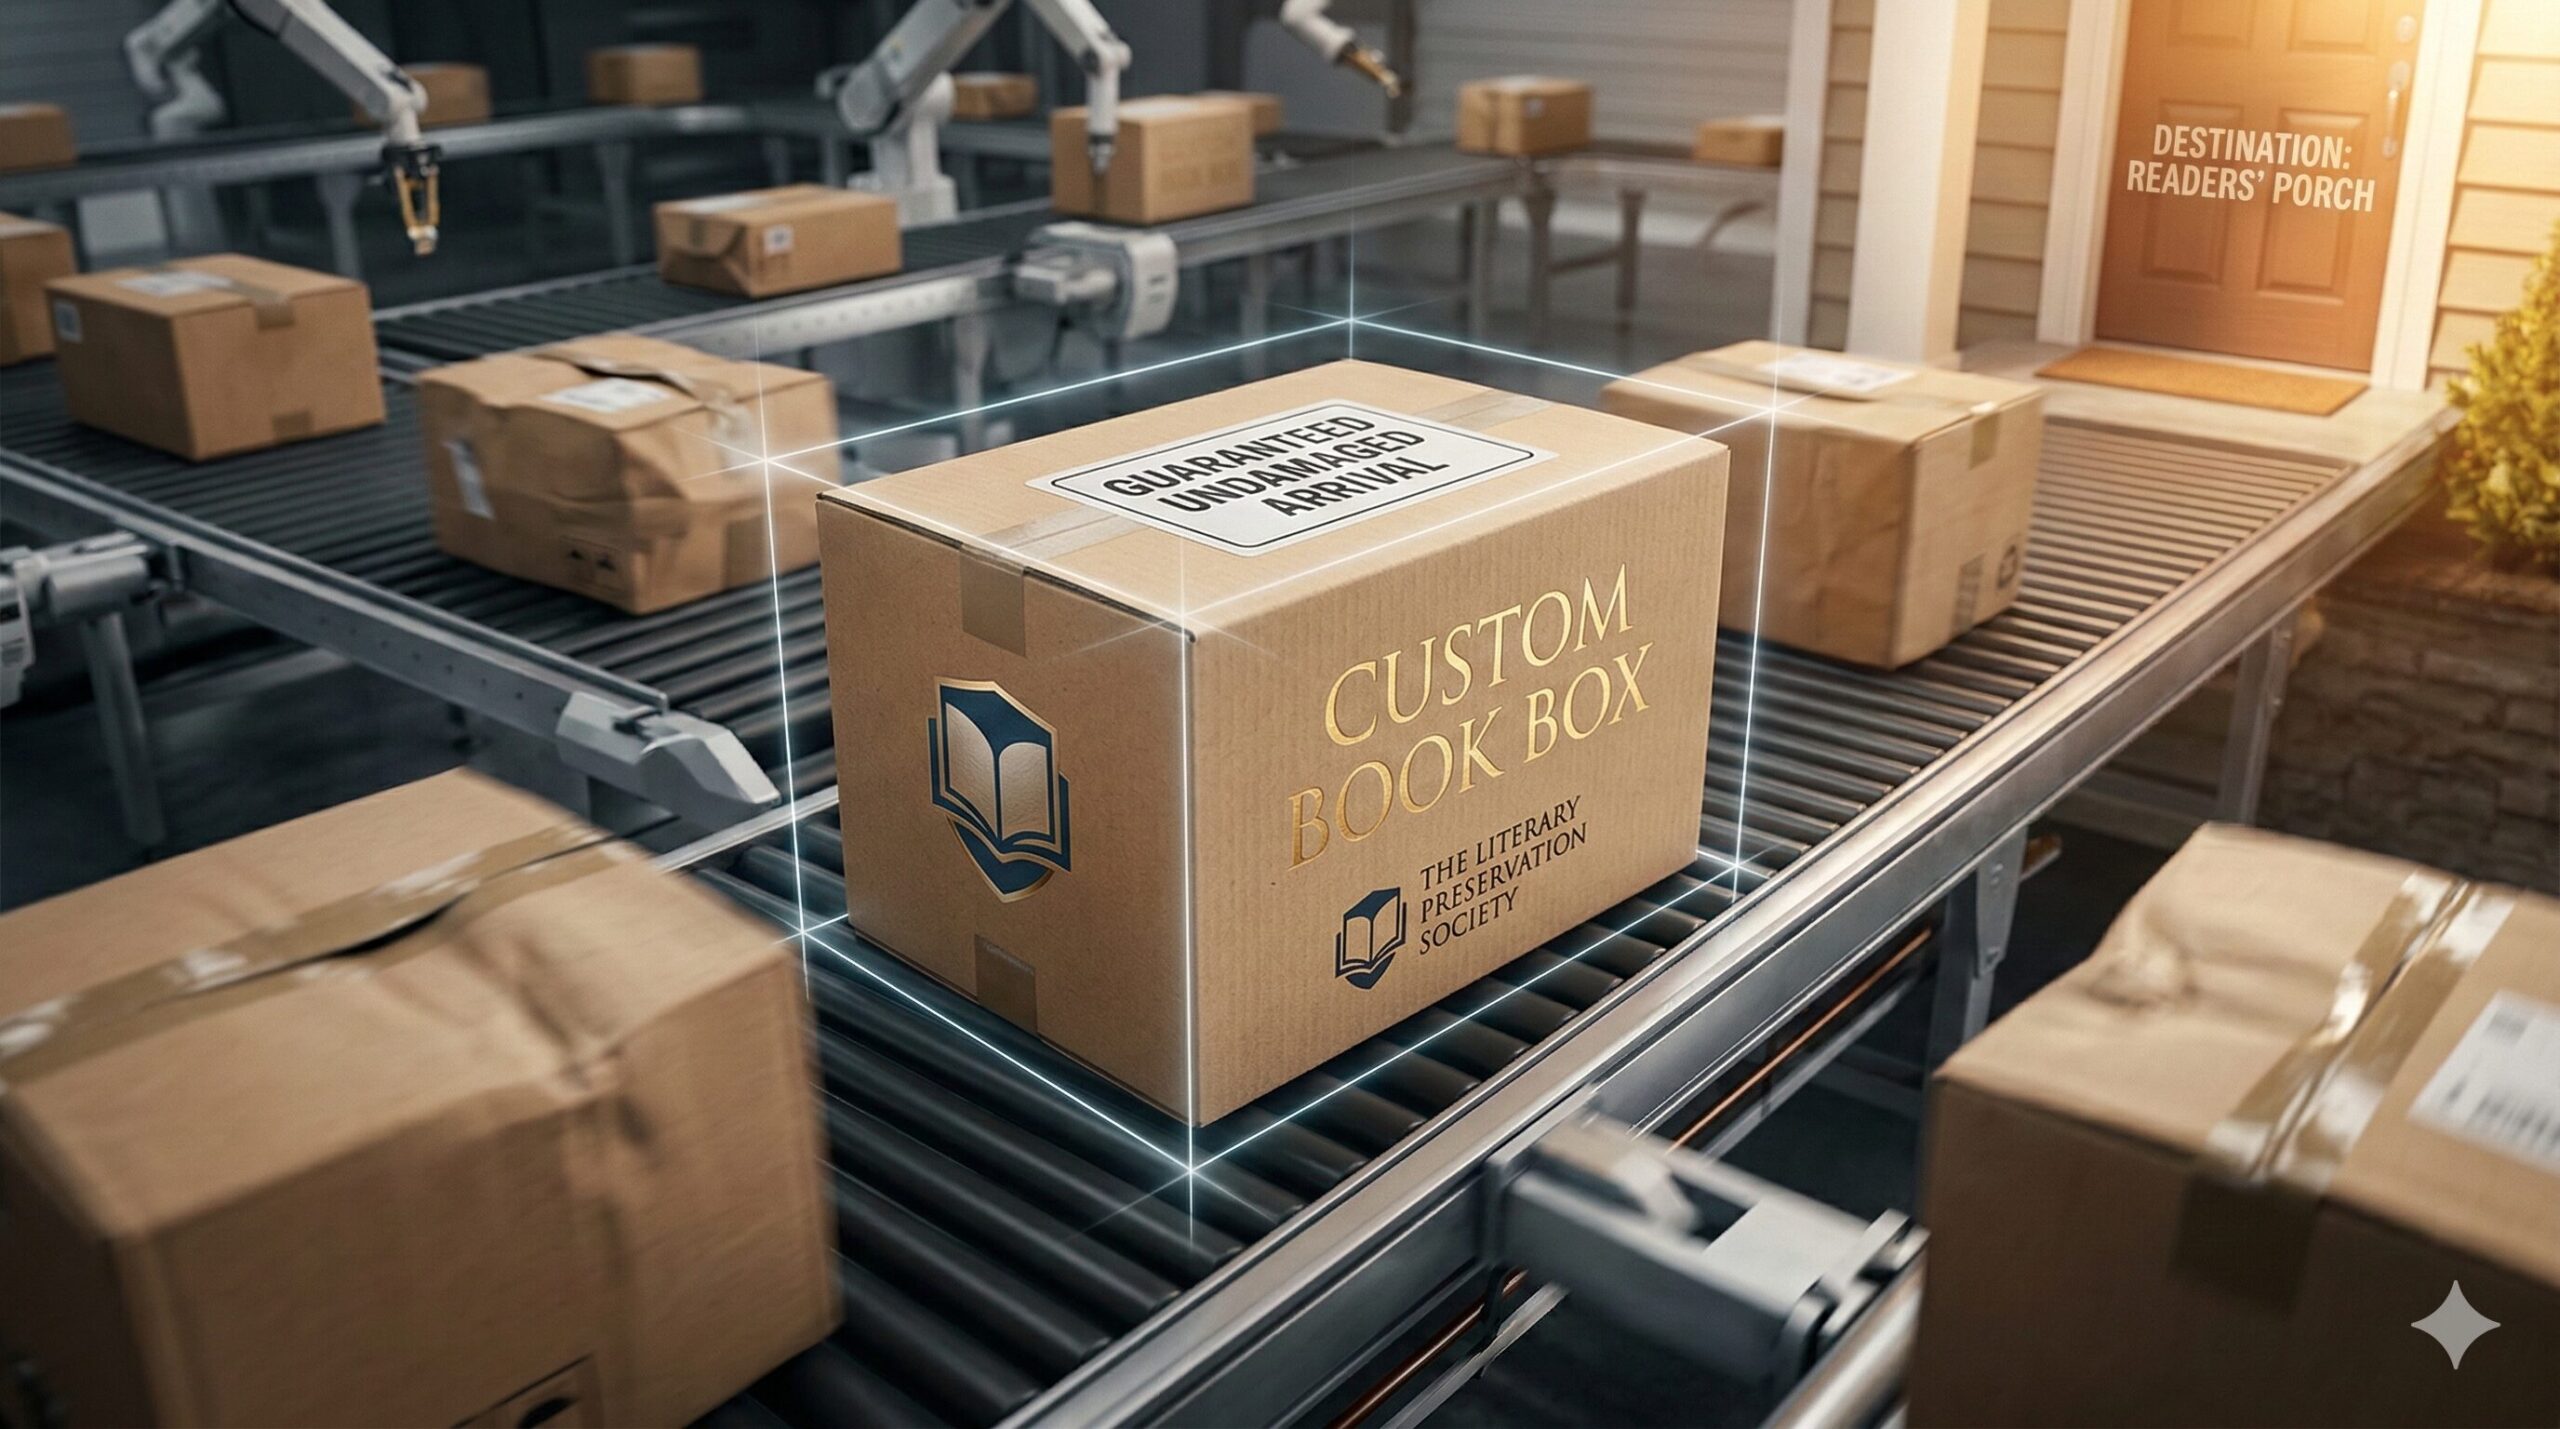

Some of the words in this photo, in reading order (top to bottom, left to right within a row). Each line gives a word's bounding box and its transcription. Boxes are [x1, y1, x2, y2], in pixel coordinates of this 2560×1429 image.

[2153, 124, 2352, 170] DESTINATION:
[2272, 172, 2376, 212] PORCH
[1102, 416, 1376, 496] GUARANTEED
[1157, 430, 1425, 512] UNDAMAGED
[1261, 457, 1450, 516] ARRIVAL
[1324, 563, 1633, 746] CUSTOM
[1287, 706, 1505, 871] BOOK
[1523, 642, 1654, 763] BOX
[1419, 849, 1468, 891] THE
[1476, 795, 1581, 866] LITERARY
[1420, 822, 1587, 924] PRESERVATION
[1419, 886, 1519, 955] SOCIETY
